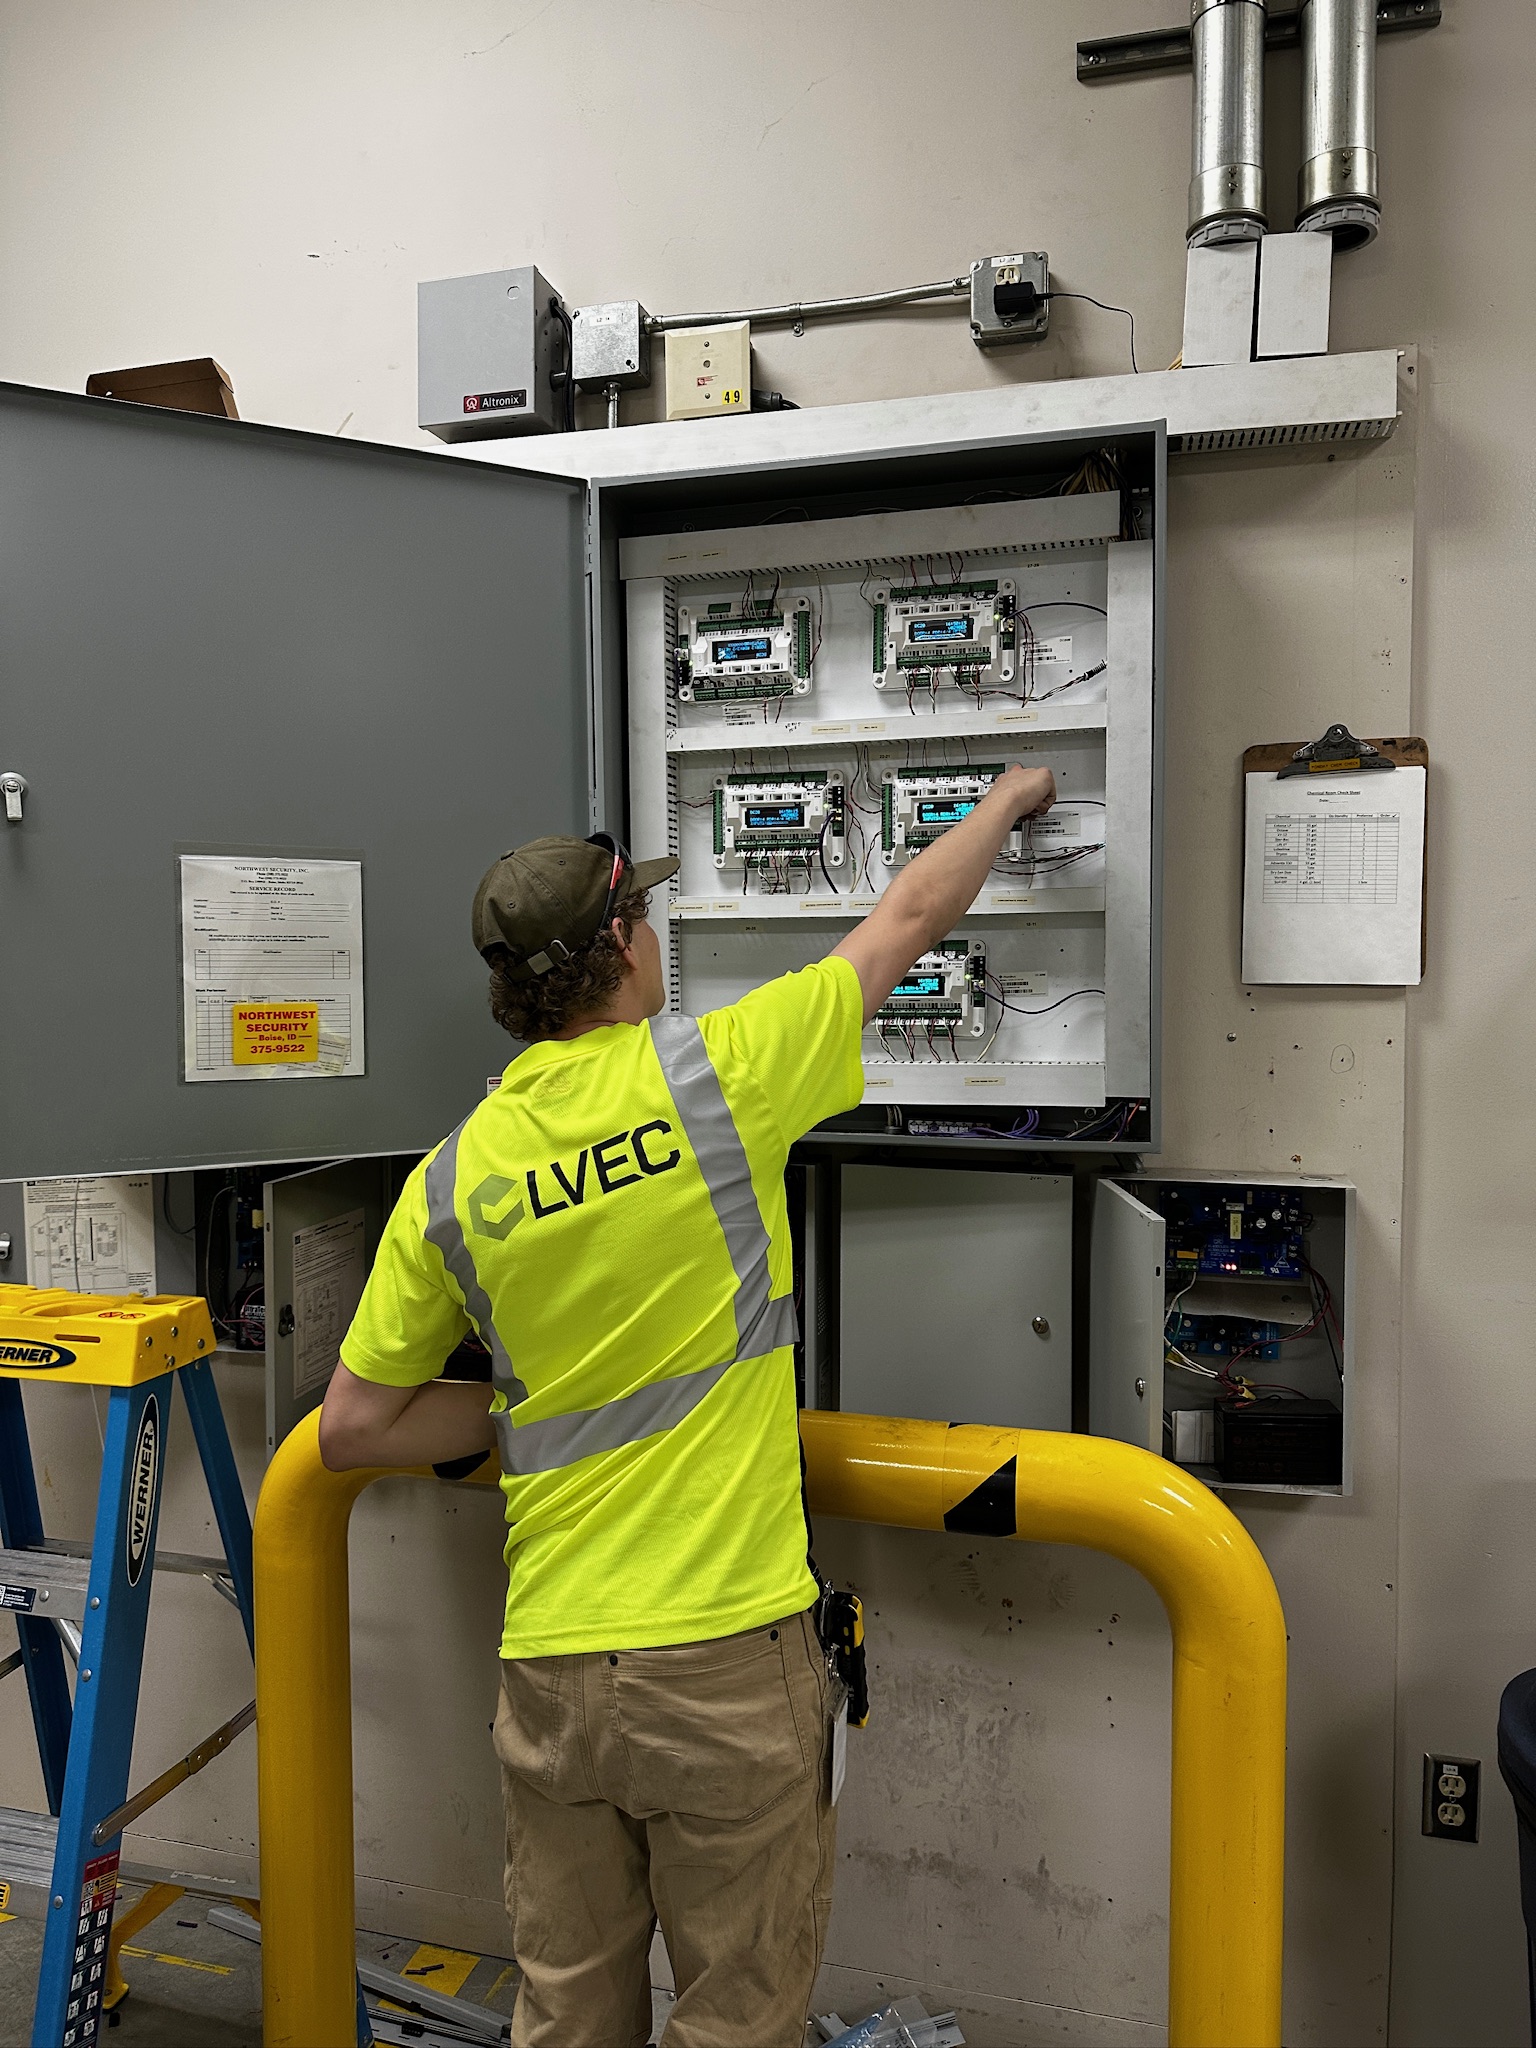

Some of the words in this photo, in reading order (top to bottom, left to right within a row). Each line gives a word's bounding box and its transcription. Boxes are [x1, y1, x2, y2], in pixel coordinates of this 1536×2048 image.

[482, 394, 520, 409] Altronix
[238, 1011, 316, 1020] NORTHWEST
[246, 1023, 309, 1032] SECURITY
[259, 1034, 285, 1042] Boise,
[250, 1044, 305, 1054] 375-9522
[132, 1431, 154, 1545] WERNER
